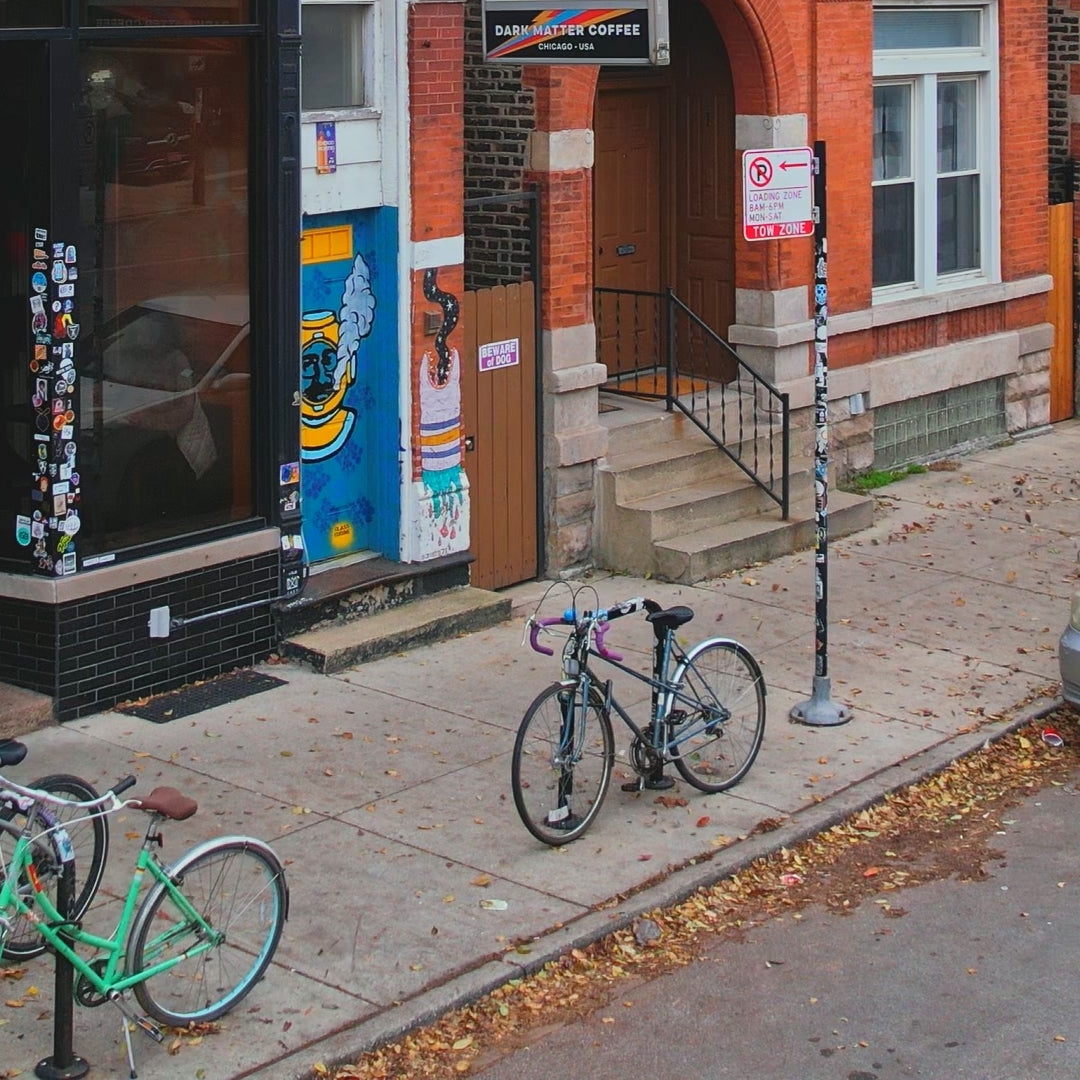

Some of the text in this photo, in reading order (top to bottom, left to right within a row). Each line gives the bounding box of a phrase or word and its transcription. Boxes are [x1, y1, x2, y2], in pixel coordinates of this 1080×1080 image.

[495, 23, 641, 36] DARK MATTER COFFEE
[538, 42, 595, 51] CHICAGO USA
[749, 190, 802, 202] LOADING ZONE
[749, 212, 783, 222] MON-SAT
[753, 223, 806, 237] TOW ZONE
[482, 343, 516, 358] BEWARE
[495, 354, 511, 365] DOG
